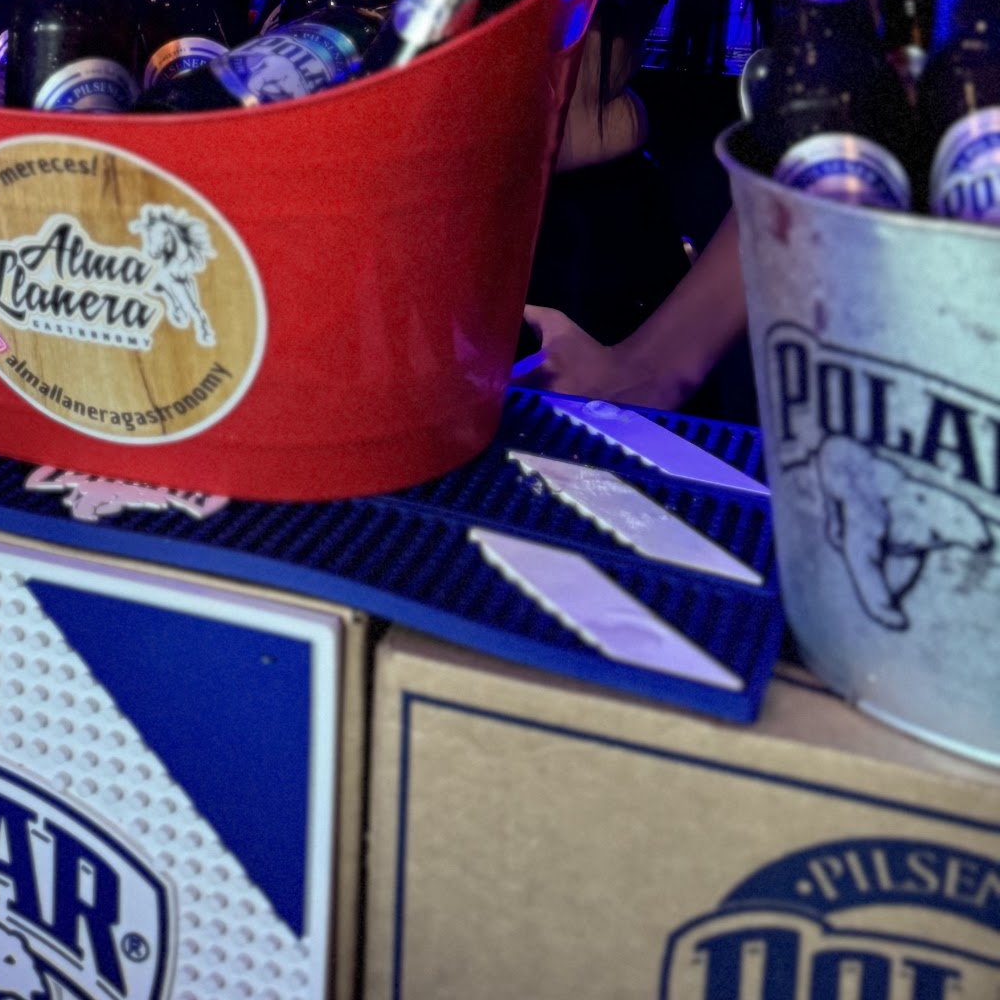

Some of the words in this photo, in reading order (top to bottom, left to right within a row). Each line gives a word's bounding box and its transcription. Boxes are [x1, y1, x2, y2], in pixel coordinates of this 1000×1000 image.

[19, 222, 152, 285] Alma
[32, 319, 152, 348] GASTRONOMY
[6, 360, 234, 432] almallaneragastronomy
[772, 341, 1000, 500] POLA
